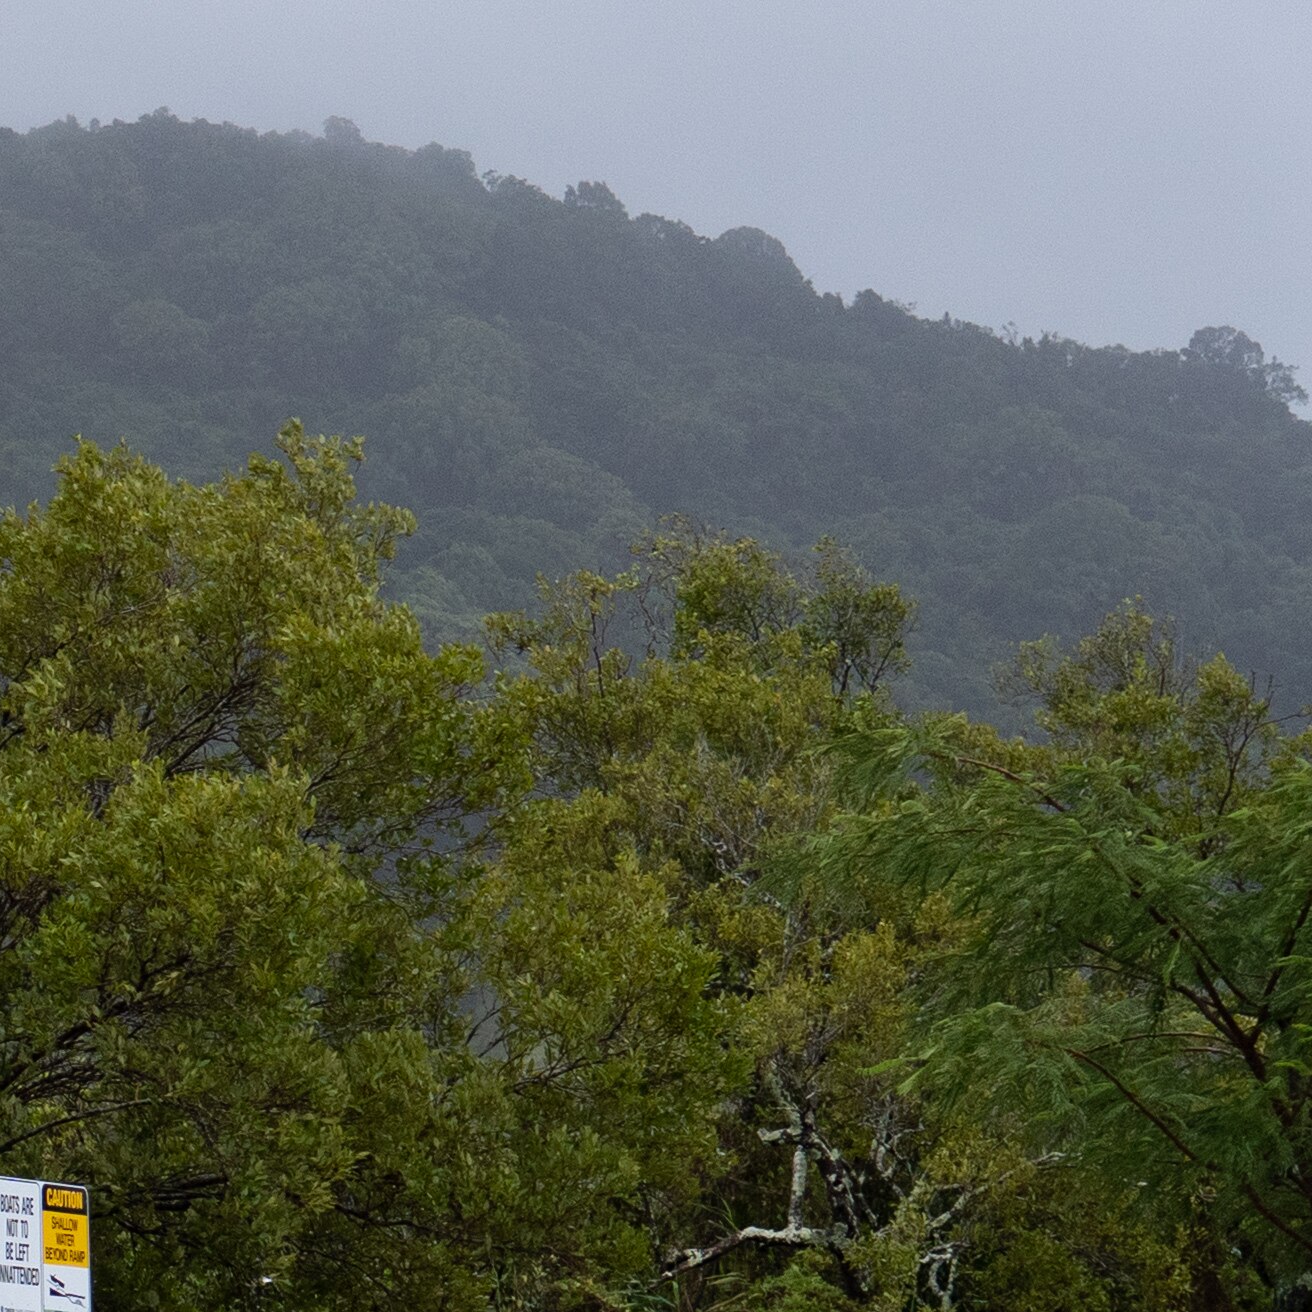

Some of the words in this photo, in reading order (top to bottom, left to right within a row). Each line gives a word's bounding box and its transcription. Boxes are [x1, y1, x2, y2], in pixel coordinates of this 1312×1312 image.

[0, 1193, 20, 1215] BOATS
[21, 1196, 34, 1216] ARE
[46, 1187, 84, 1210] CAUTION
[6, 1219, 19, 1238] NOT
[20, 1219, 29, 1239] TO
[51, 1216, 78, 1231] SHALLOW
[56, 1232, 75, 1248] WATER
[5, 1241, 14, 1260] BE
[15, 1243, 30, 1262] LEFT
[45, 1246, 68, 1262] BEYOND
[69, 1249, 86, 1264] RAMP
